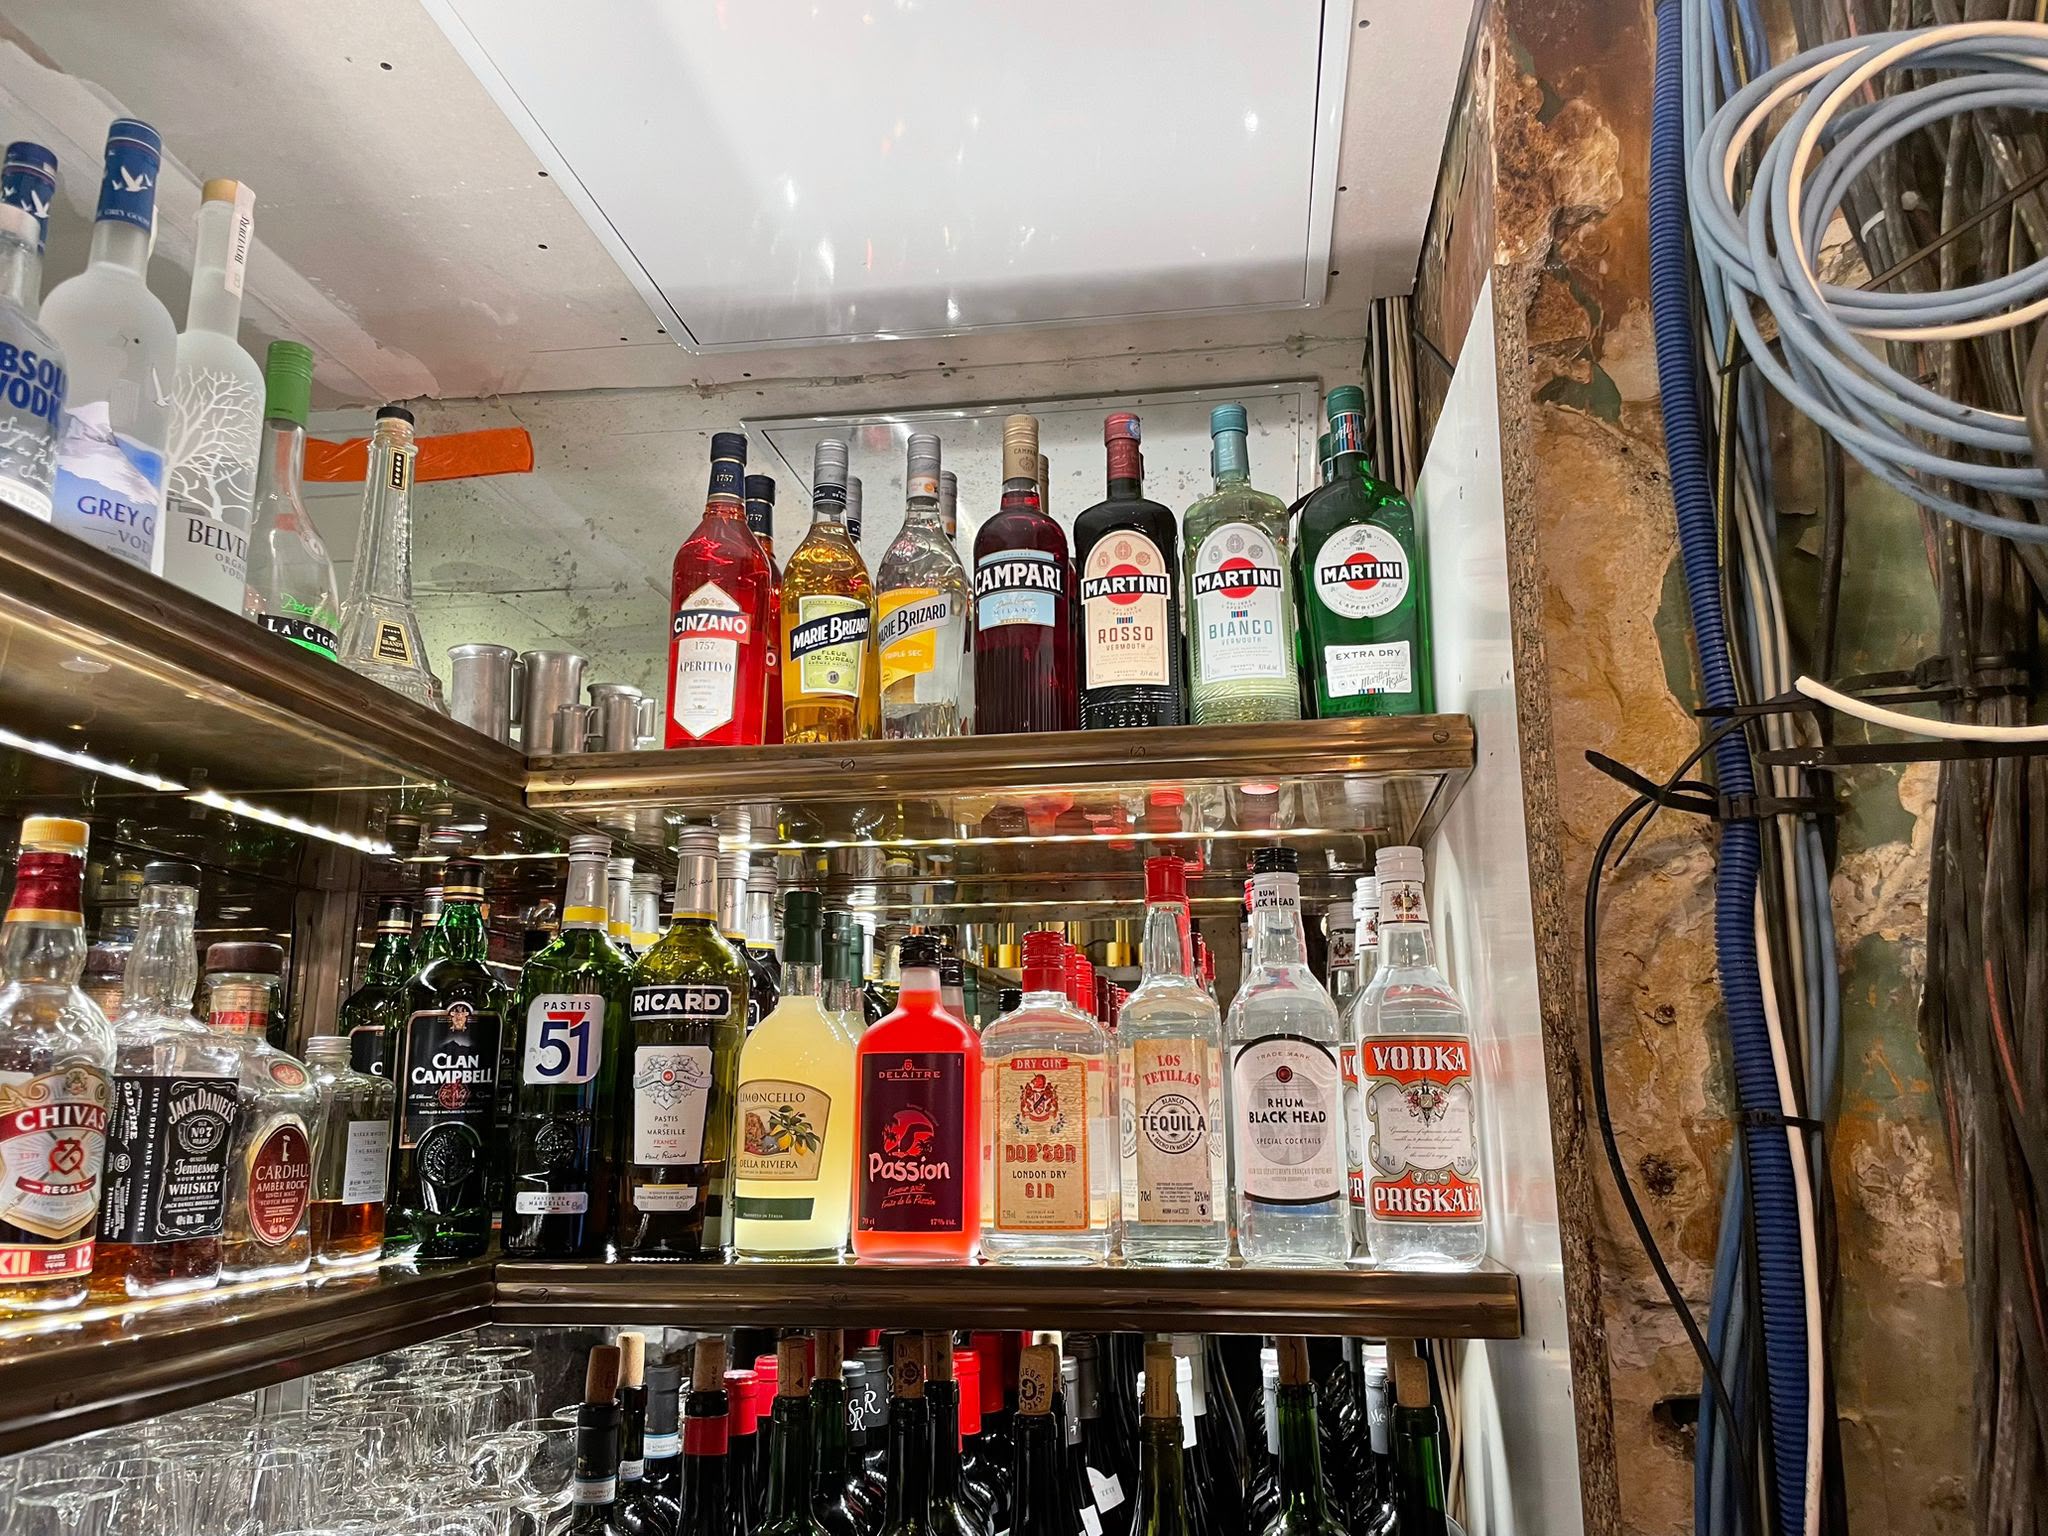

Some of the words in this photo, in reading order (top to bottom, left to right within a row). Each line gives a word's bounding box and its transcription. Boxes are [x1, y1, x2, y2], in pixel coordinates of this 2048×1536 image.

[1013, 447, 1037, 457] CAMPAR
[716, 474, 734, 483] 1757
[77, 495, 139, 527] GREY
[975, 563, 1063, 596] CAMPARI
[1197, 569, 1279, 593] MARTINI
[1323, 565, 1401, 585] MARTINI
[1085, 577, 1165, 598] MARTINI
[897, 603, 946, 636] BRIZARD
[993, 607, 1037, 615] MILANO
[266, 618, 292, 635] LA
[674, 613, 747, 634] CINZANO
[1209, 620, 1273, 640] BIANCO
[792, 623, 830, 652] MARIE
[830, 616, 868, 643] BRIZARD
[1098, 626, 1154, 644] ROSSO
[695, 641, 715, 651] 1757
[821, 649, 847, 657] FLEUR
[1105, 643, 1146, 651] VERMOUTH
[1335, 651, 1375, 661] EXTRA
[1378, 649, 1402, 657] DRY
[1270, 898, 1294, 906] HEAD
[543, 1001, 591, 1010] PASTIS
[634, 993, 720, 1012] RICARD
[536, 1021, 590, 1077] 51
[1256, 1052, 1283, 1060] TRADE
[1287, 1052, 1311, 1060] MARK
[432, 1053, 479, 1069] CLAN
[1016, 1059, 1036, 1069] DRY
[1042, 1058, 1062, 1068] GIN
[1157, 1055, 1180, 1066] LOS
[1373, 1046, 1467, 1071] VODKA
[412, 1066, 493, 1084] CAMPBELL
[1143, 1069, 1201, 1086] TETILLAS
[124, 1081, 134, 1107] OLD
[151, 1087, 160, 1114] EVERY
[1161, 1097, 1184, 1105] BLANCO
[168, 1093, 196, 1125] JACK
[197, 1088, 238, 1125] DANIEL'S
[1267, 1098, 1304, 1108] RHUM
[15, 1105, 107, 1131] CHIVAS
[128, 1107, 139, 1140] TIME
[1140, 1115, 1206, 1131] TEQUILA
[1249, 1111, 1288, 1123] BLACK
[1292, 1111, 1326, 1123] HEAD
[148, 1117, 157, 1140] DROP
[1256, 1137, 1282, 1145] SPECIAL
[1285, 1137, 1321, 1145] COCKTAILS
[144, 1142, 152, 1166] MADE
[1005, 1143, 1076, 1164] DOB'SON
[174, 1158, 220, 1175] Tennessee
[760, 1160, 799, 1169] RIVIERA
[868, 1153, 951, 1183] Passion
[143, 1169, 150, 1180] IN
[1012, 1170, 1047, 1179] LONDON
[1050, 1170, 1067, 1179] DRY
[42, 1183, 83, 1195] REGAL
[168, 1181, 221, 1195] WHISKEY
[256, 1182, 285, 1193] AMBER
[286, 1179, 307, 1189] ROCK
[1025, 1183, 1055, 1199] GIN
[1140, 1190, 1151, 1202] 70cl
[1375, 1186, 1482, 1213] PRISKAÏA
[137, 1183, 149, 1233] TENNESSEE
[75, 1245, 92, 1269] 12
